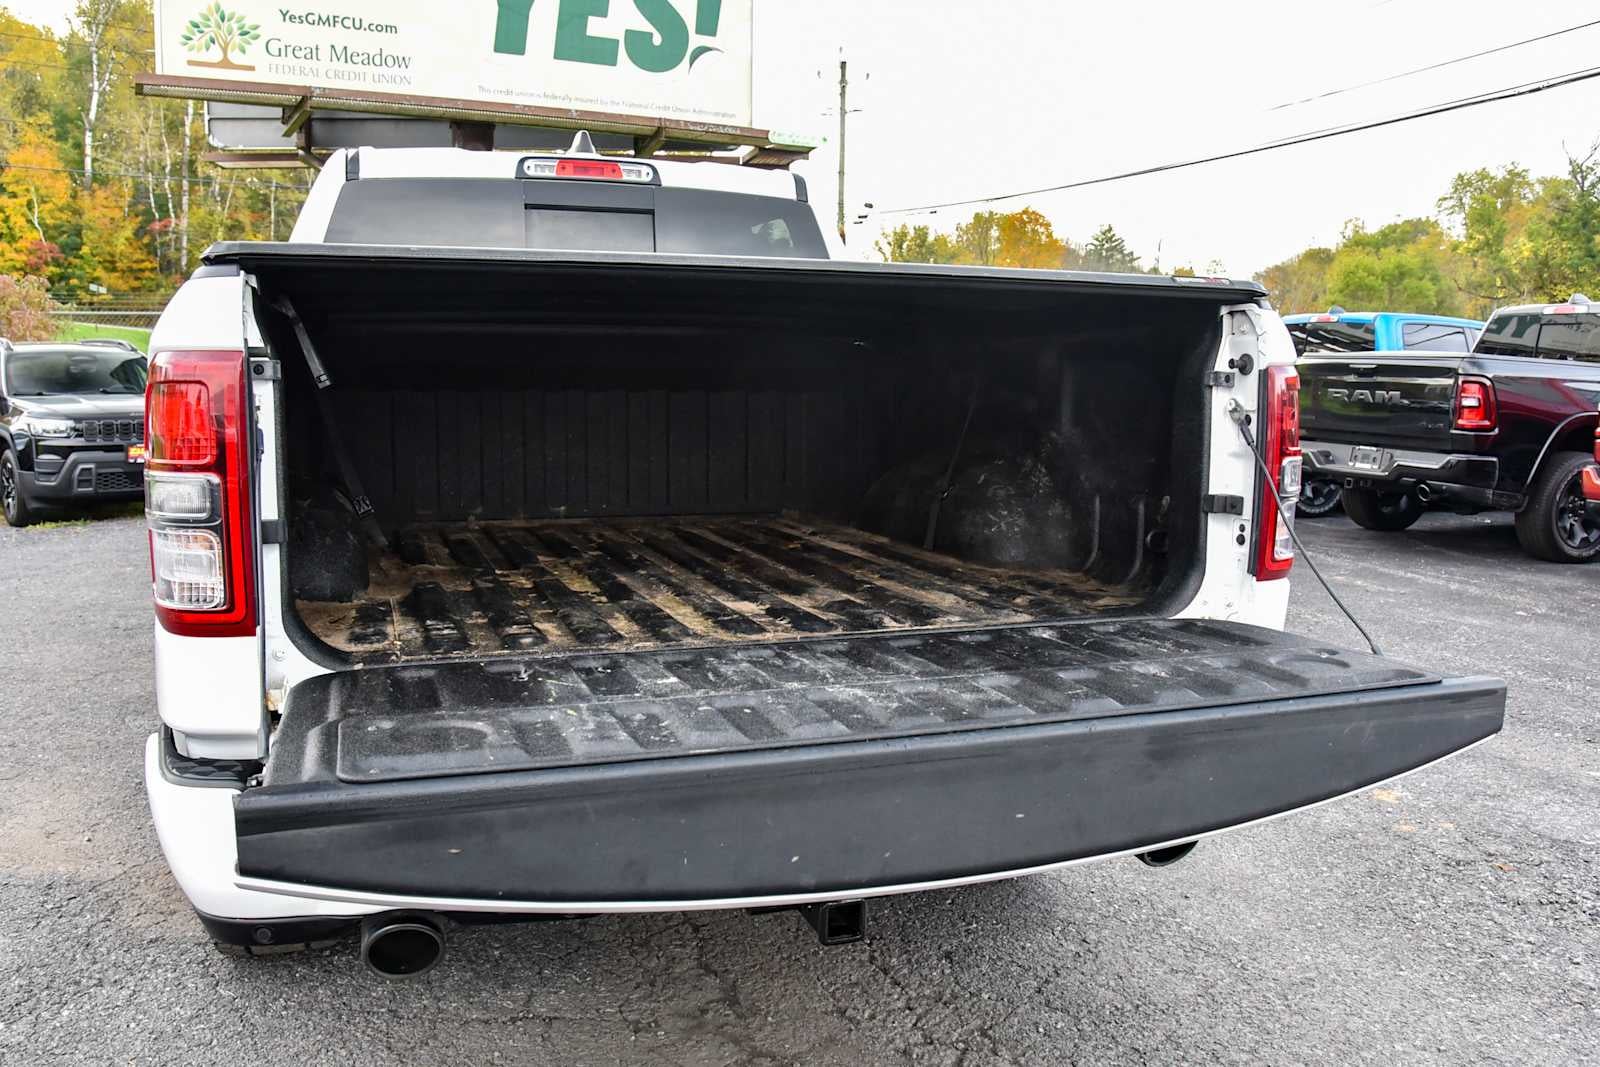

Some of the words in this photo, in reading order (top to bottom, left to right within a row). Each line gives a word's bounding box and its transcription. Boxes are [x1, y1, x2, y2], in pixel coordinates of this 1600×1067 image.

[279, 9, 398, 34] YesGMFCU.com
[265, 38, 321, 61] Great
[330, 44, 412, 69] Meadow
[268, 63, 320, 78] FEDERAL
[325, 68, 368, 82] CREDIT
[371, 72, 412, 86] UNION
[493, 88, 514, 97] credit
[1327, 388, 1401, 405] RAM
